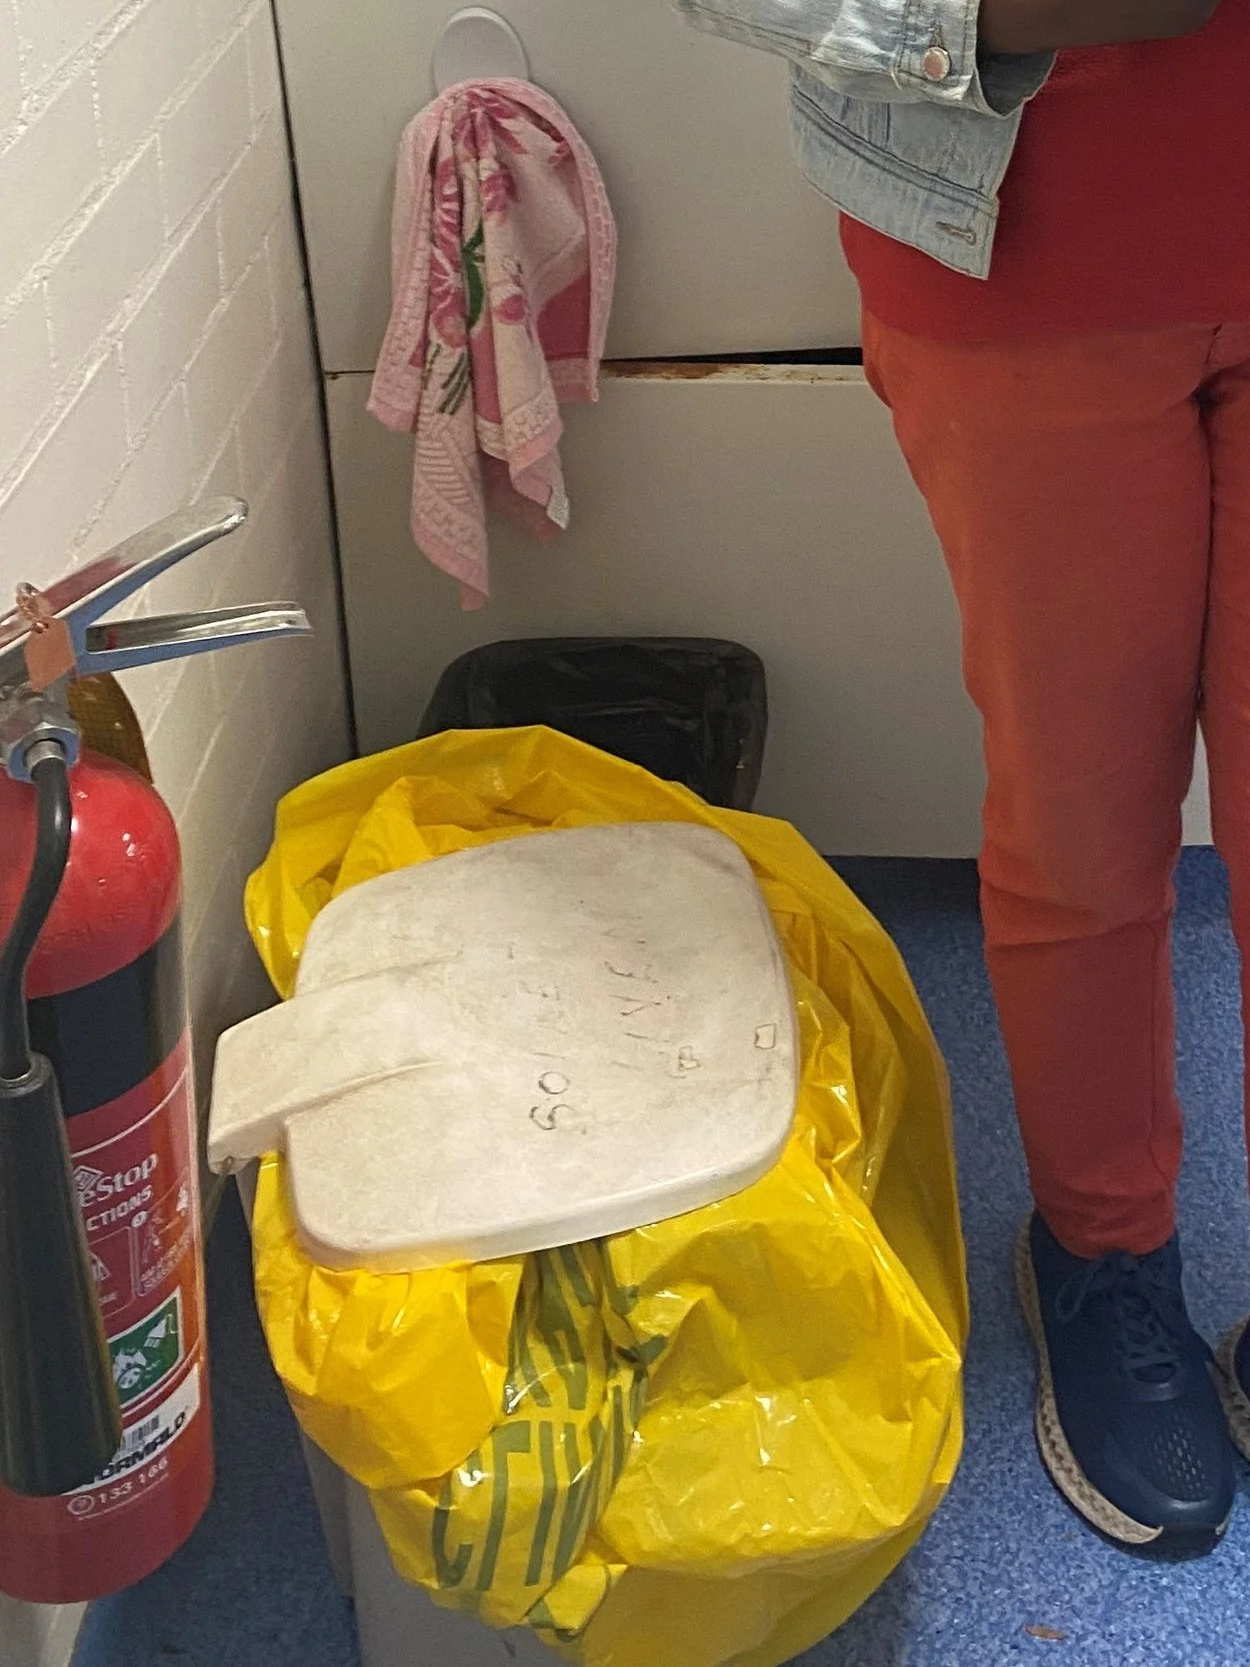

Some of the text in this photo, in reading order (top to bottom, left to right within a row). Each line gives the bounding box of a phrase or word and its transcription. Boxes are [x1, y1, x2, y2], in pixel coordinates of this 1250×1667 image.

[79, 1153, 158, 1207] eStop
[86, 1185, 152, 1231] CTIONS
[97, 1412, 184, 1480] ORMALD
[100, 1482, 132, 1503] 133
